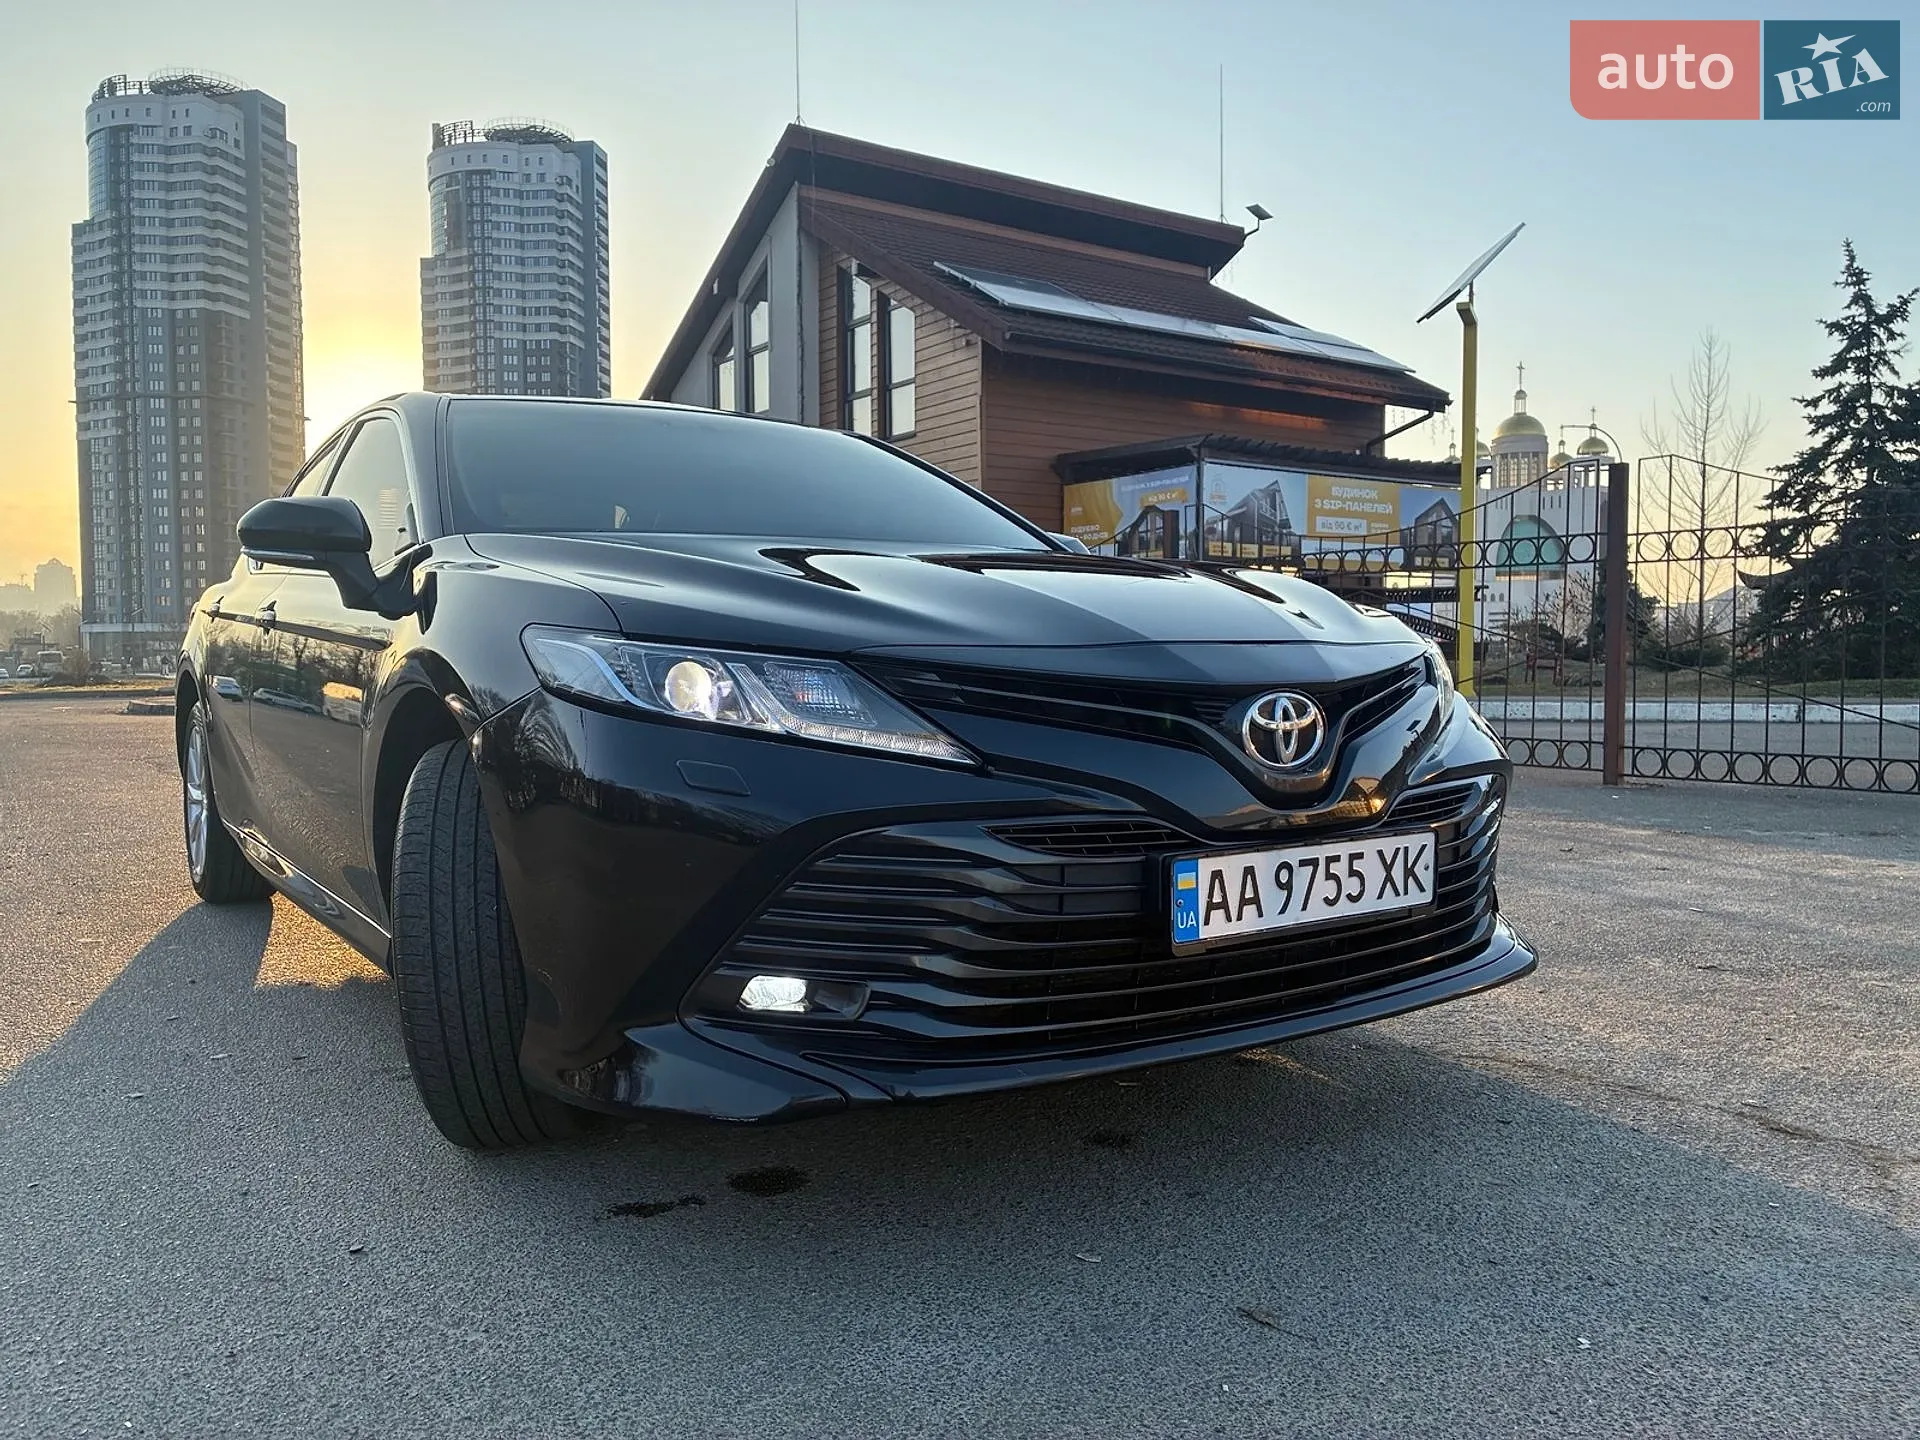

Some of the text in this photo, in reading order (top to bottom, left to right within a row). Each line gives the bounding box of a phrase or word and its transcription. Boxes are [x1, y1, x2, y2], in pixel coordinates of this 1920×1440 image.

[1331, 486, 1378, 500] БУДИНОК
[1323, 499, 1393, 514] SIP-ПАНЕЛЕЙ
[1203, 843, 1428, 926] AA 9755 XK
[1177, 912, 1197, 929] UA
